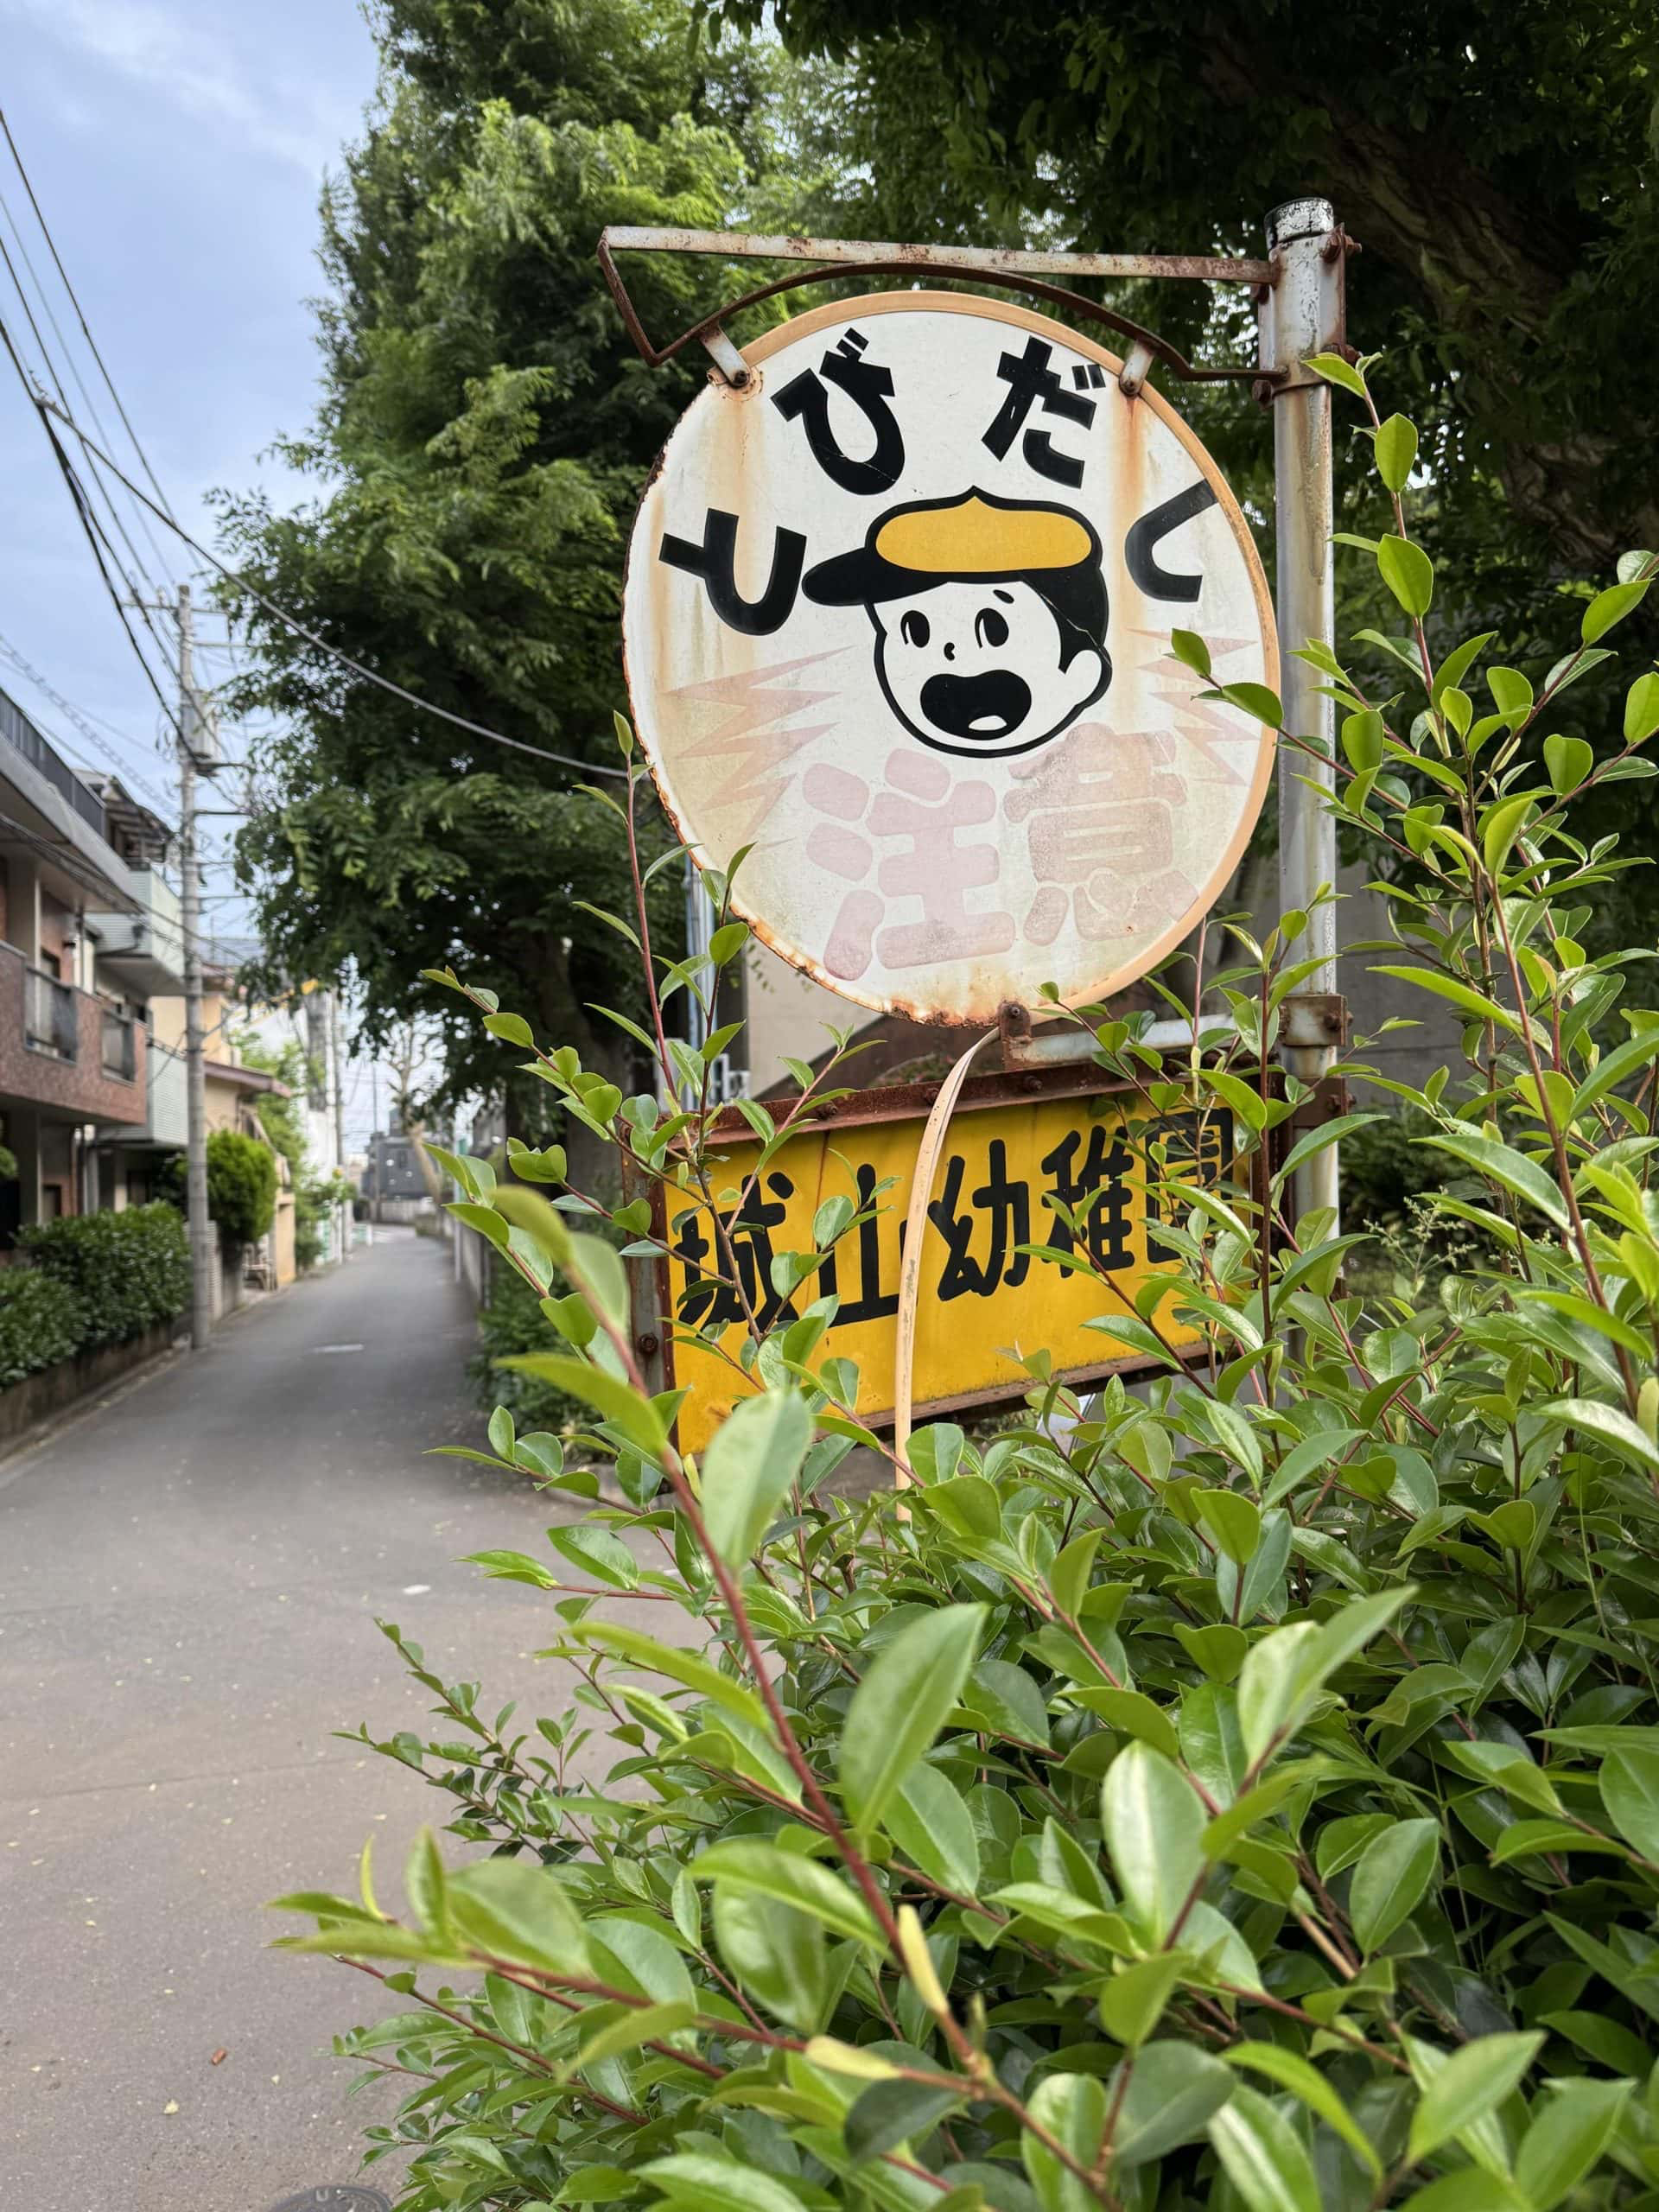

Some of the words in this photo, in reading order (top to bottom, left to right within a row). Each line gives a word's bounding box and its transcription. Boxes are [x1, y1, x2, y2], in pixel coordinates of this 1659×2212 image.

[658, 327, 1218, 635] とびだし
[803, 722, 1198, 981] 注意
